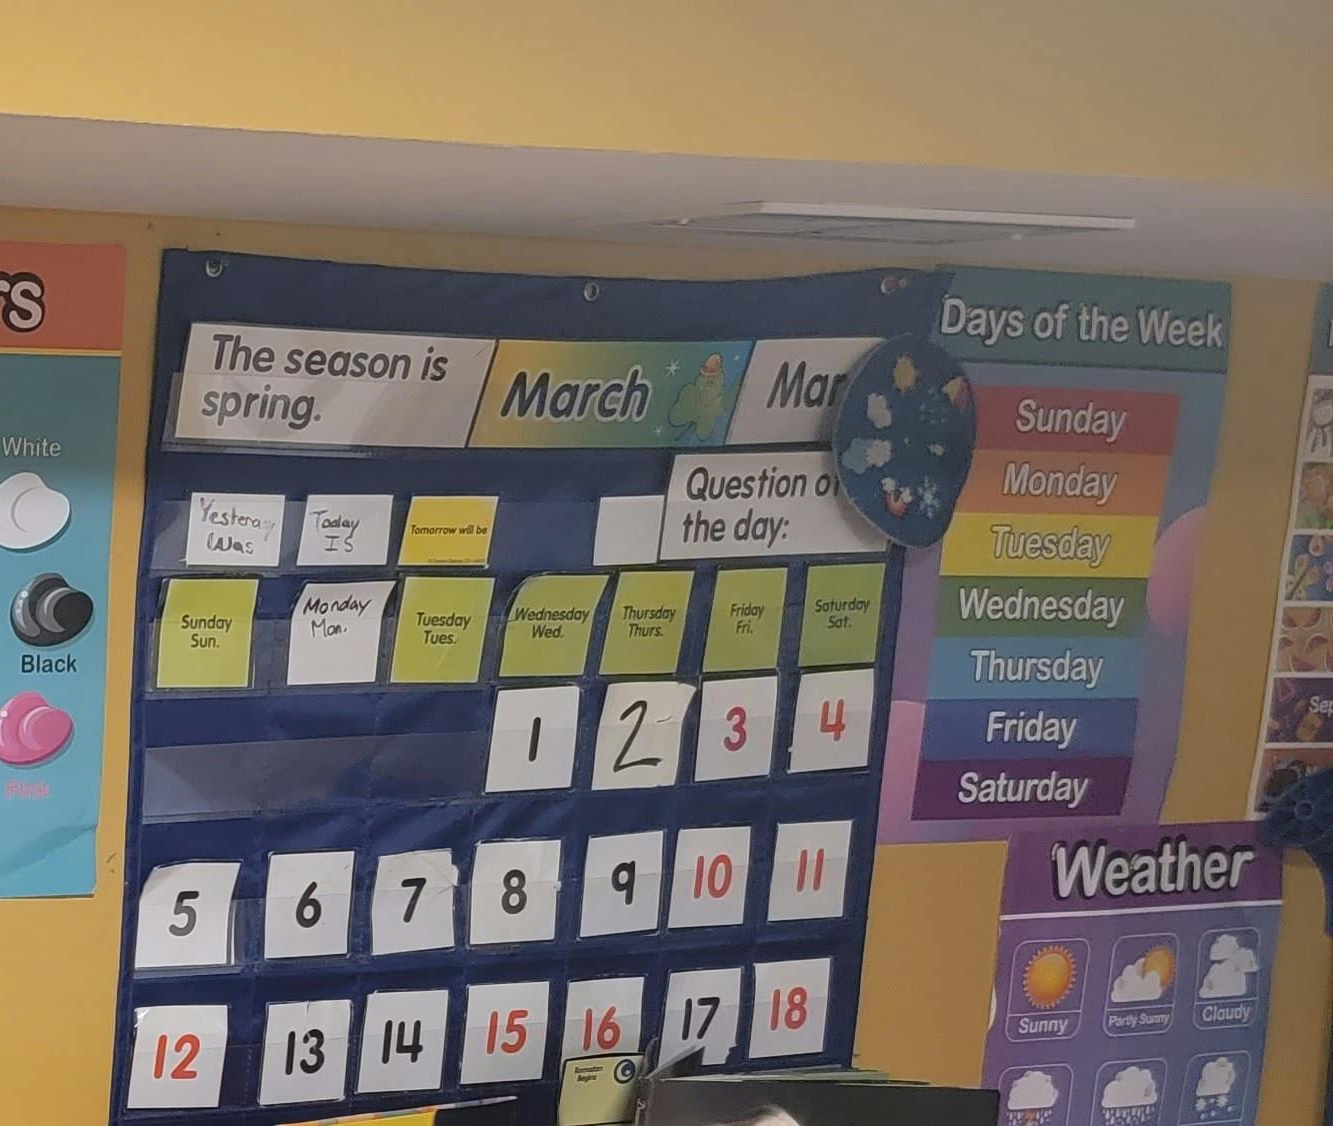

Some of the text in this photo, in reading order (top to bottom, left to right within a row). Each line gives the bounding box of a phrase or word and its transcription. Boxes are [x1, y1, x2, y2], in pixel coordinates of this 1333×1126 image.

[941, 298, 1224, 349] Days of the Week
[211, 334, 449, 382] The season is
[201, 385, 322, 430] spring.
[500, 367, 651, 421] March
[1015, 400, 1126, 442] Sunday
[2, 437, 61, 458] White
[686, 467, 806, 501] Question
[1003, 463, 1118, 505] Monday
[411, 525, 487, 535] Tomorrow will be
[683, 509, 789, 548] the day:
[990, 526, 1111, 567] Tuesday
[181, 615, 232, 632] Sunday
[303, 598, 371, 617] Monday
[416, 612, 471, 631] Tuesday
[514, 607, 590, 624] Wednesday
[622, 606, 677, 624] Thursday
[730, 602, 764, 619] Friday
[815, 598, 870, 616] Saturday
[958, 588, 1124, 627] Wednesday
[190, 634, 220, 649] Sun.
[423, 631, 457, 645] Tues.
[531, 625, 563, 639] Wed.
[628, 623, 663, 637] Thurs.
[21, 655, 77, 673] Black
[969, 649, 1103, 688] Thursday
[528, 717, 541, 761] 1
[613, 701, 662, 772] 2
[723, 706, 747, 751] 3
[819, 699, 845, 741] 4
[986, 712, 1076, 750] Friday
[958, 773, 1088, 807] Saturday
[693, 854, 732, 899] 10
[1052, 839, 1255, 898] Weather
[500, 869, 528, 914] 8
[168, 891, 199, 936] 5
[770, 987, 808, 1031] 18
[1018, 1017, 1068, 1035] Sunny
[1108, 1013, 1169, 1027] Partly Sunny
[1203, 1005, 1251, 1023] Cloudy
[486, 1009, 529, 1055] 15
[153, 1033, 202, 1081] 12
[285, 1029, 326, 1075] 13
